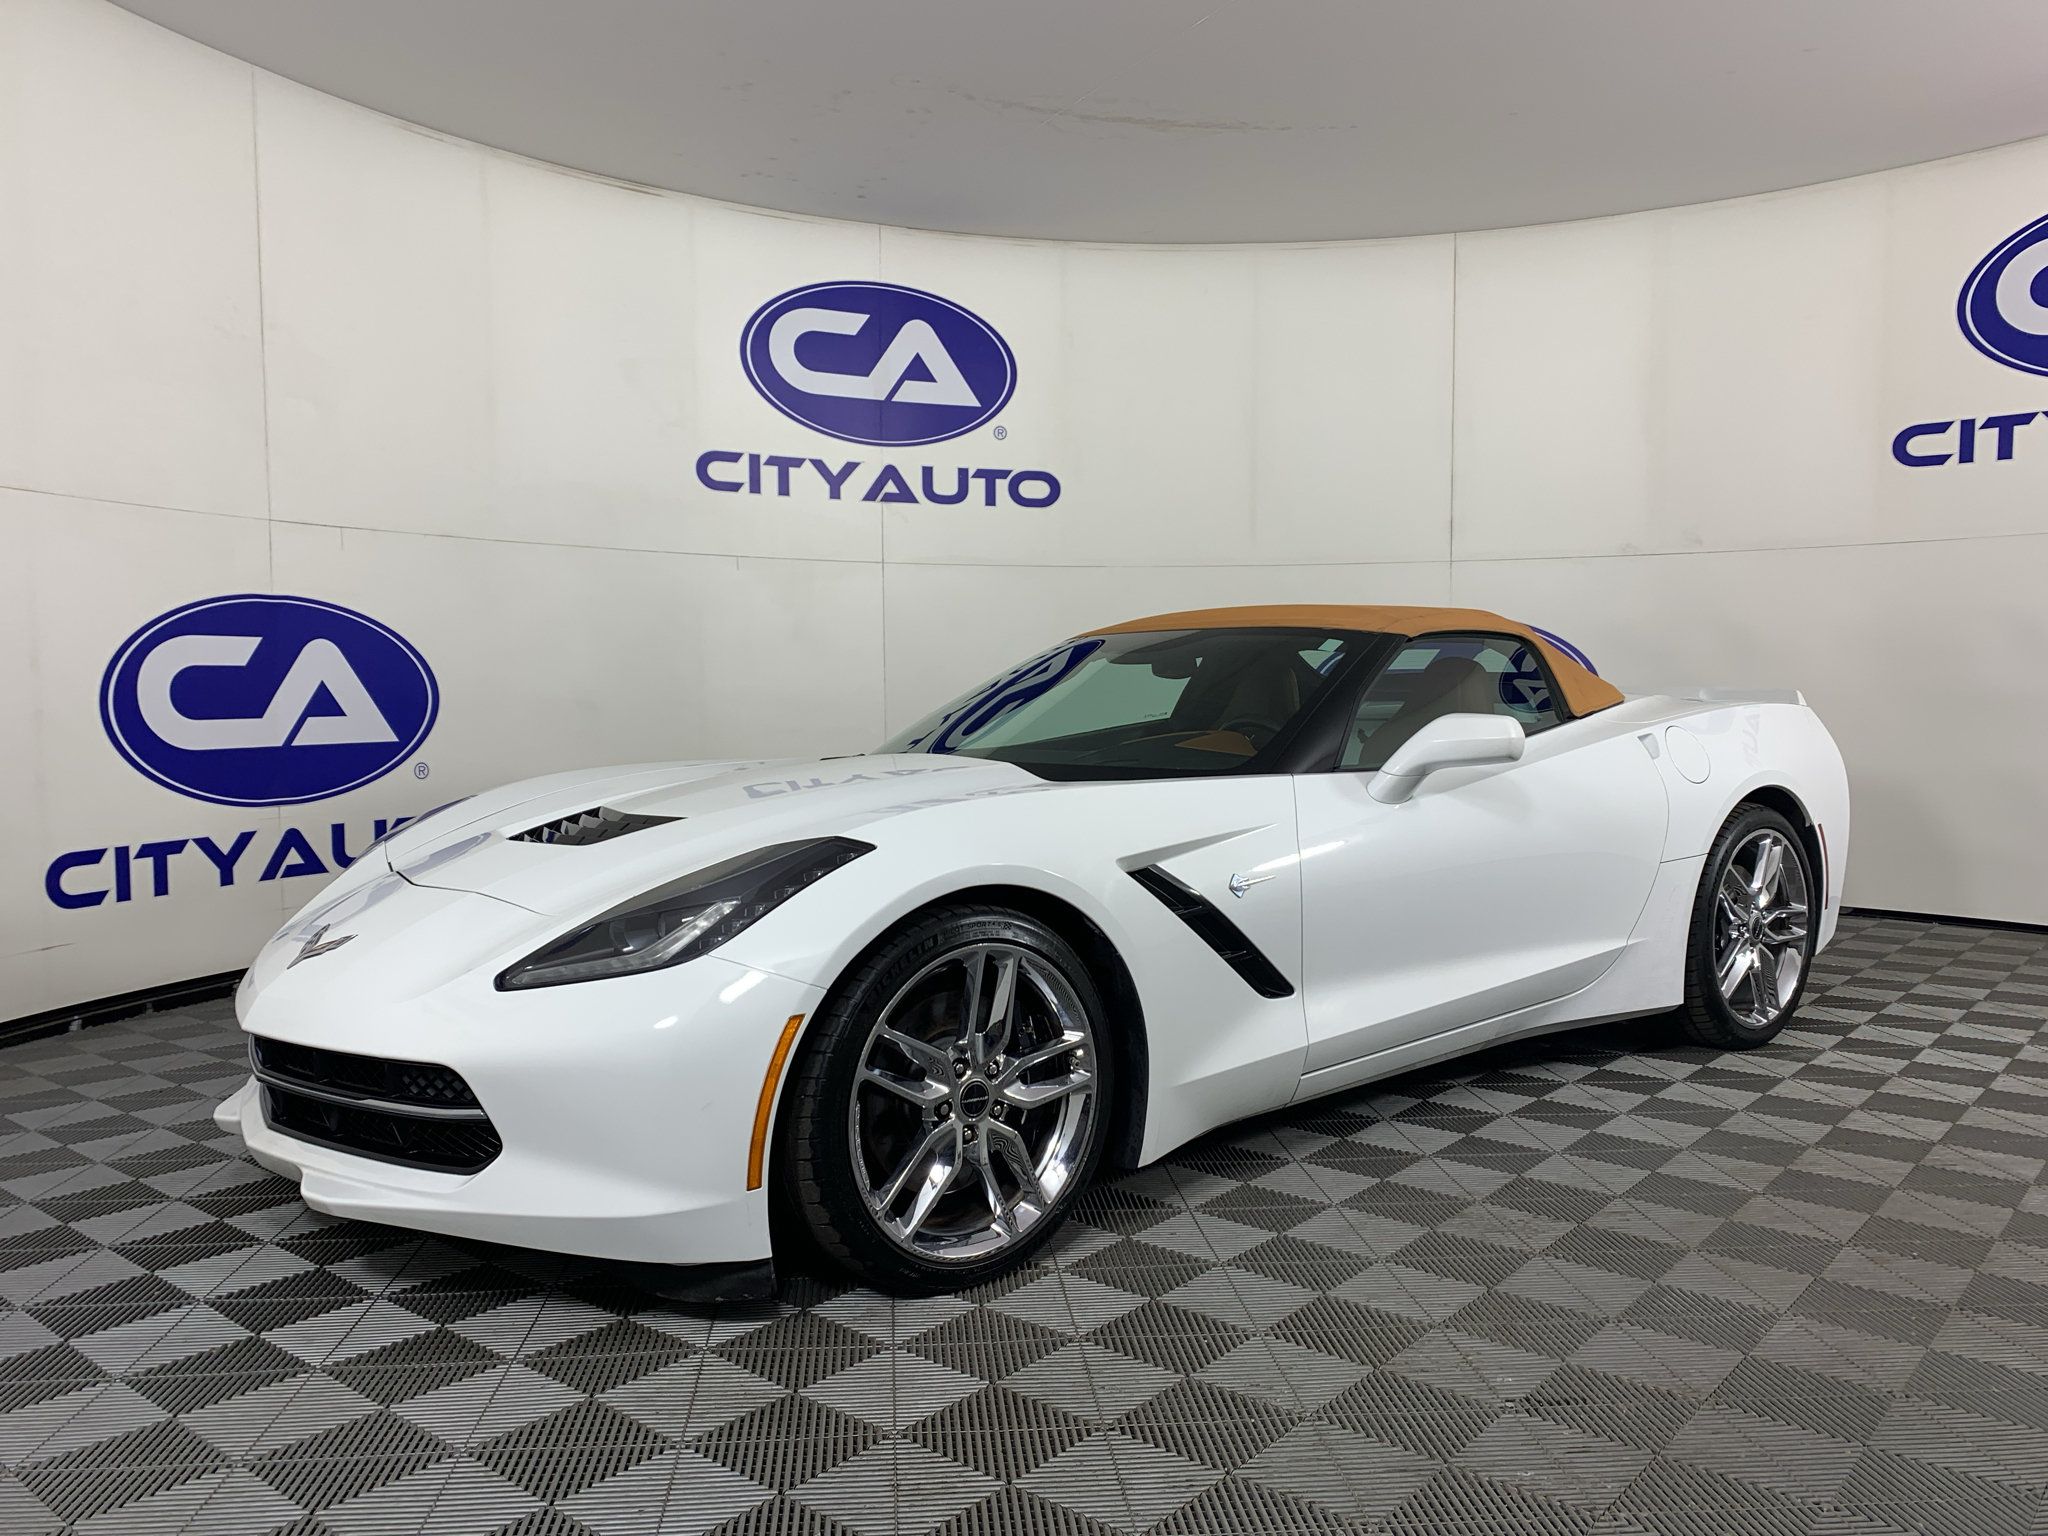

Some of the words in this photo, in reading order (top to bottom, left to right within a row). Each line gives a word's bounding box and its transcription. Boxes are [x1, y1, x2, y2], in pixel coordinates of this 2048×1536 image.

[768, 307, 982, 408] CA
[695, 450, 862, 500] CITY
[861, 464, 1061, 508] AUTO
[1892, 411, 2048, 467] CIT
[137, 634, 400, 751] CA
[45, 829, 258, 910] CITY
[258, 815, 418, 882] AU
